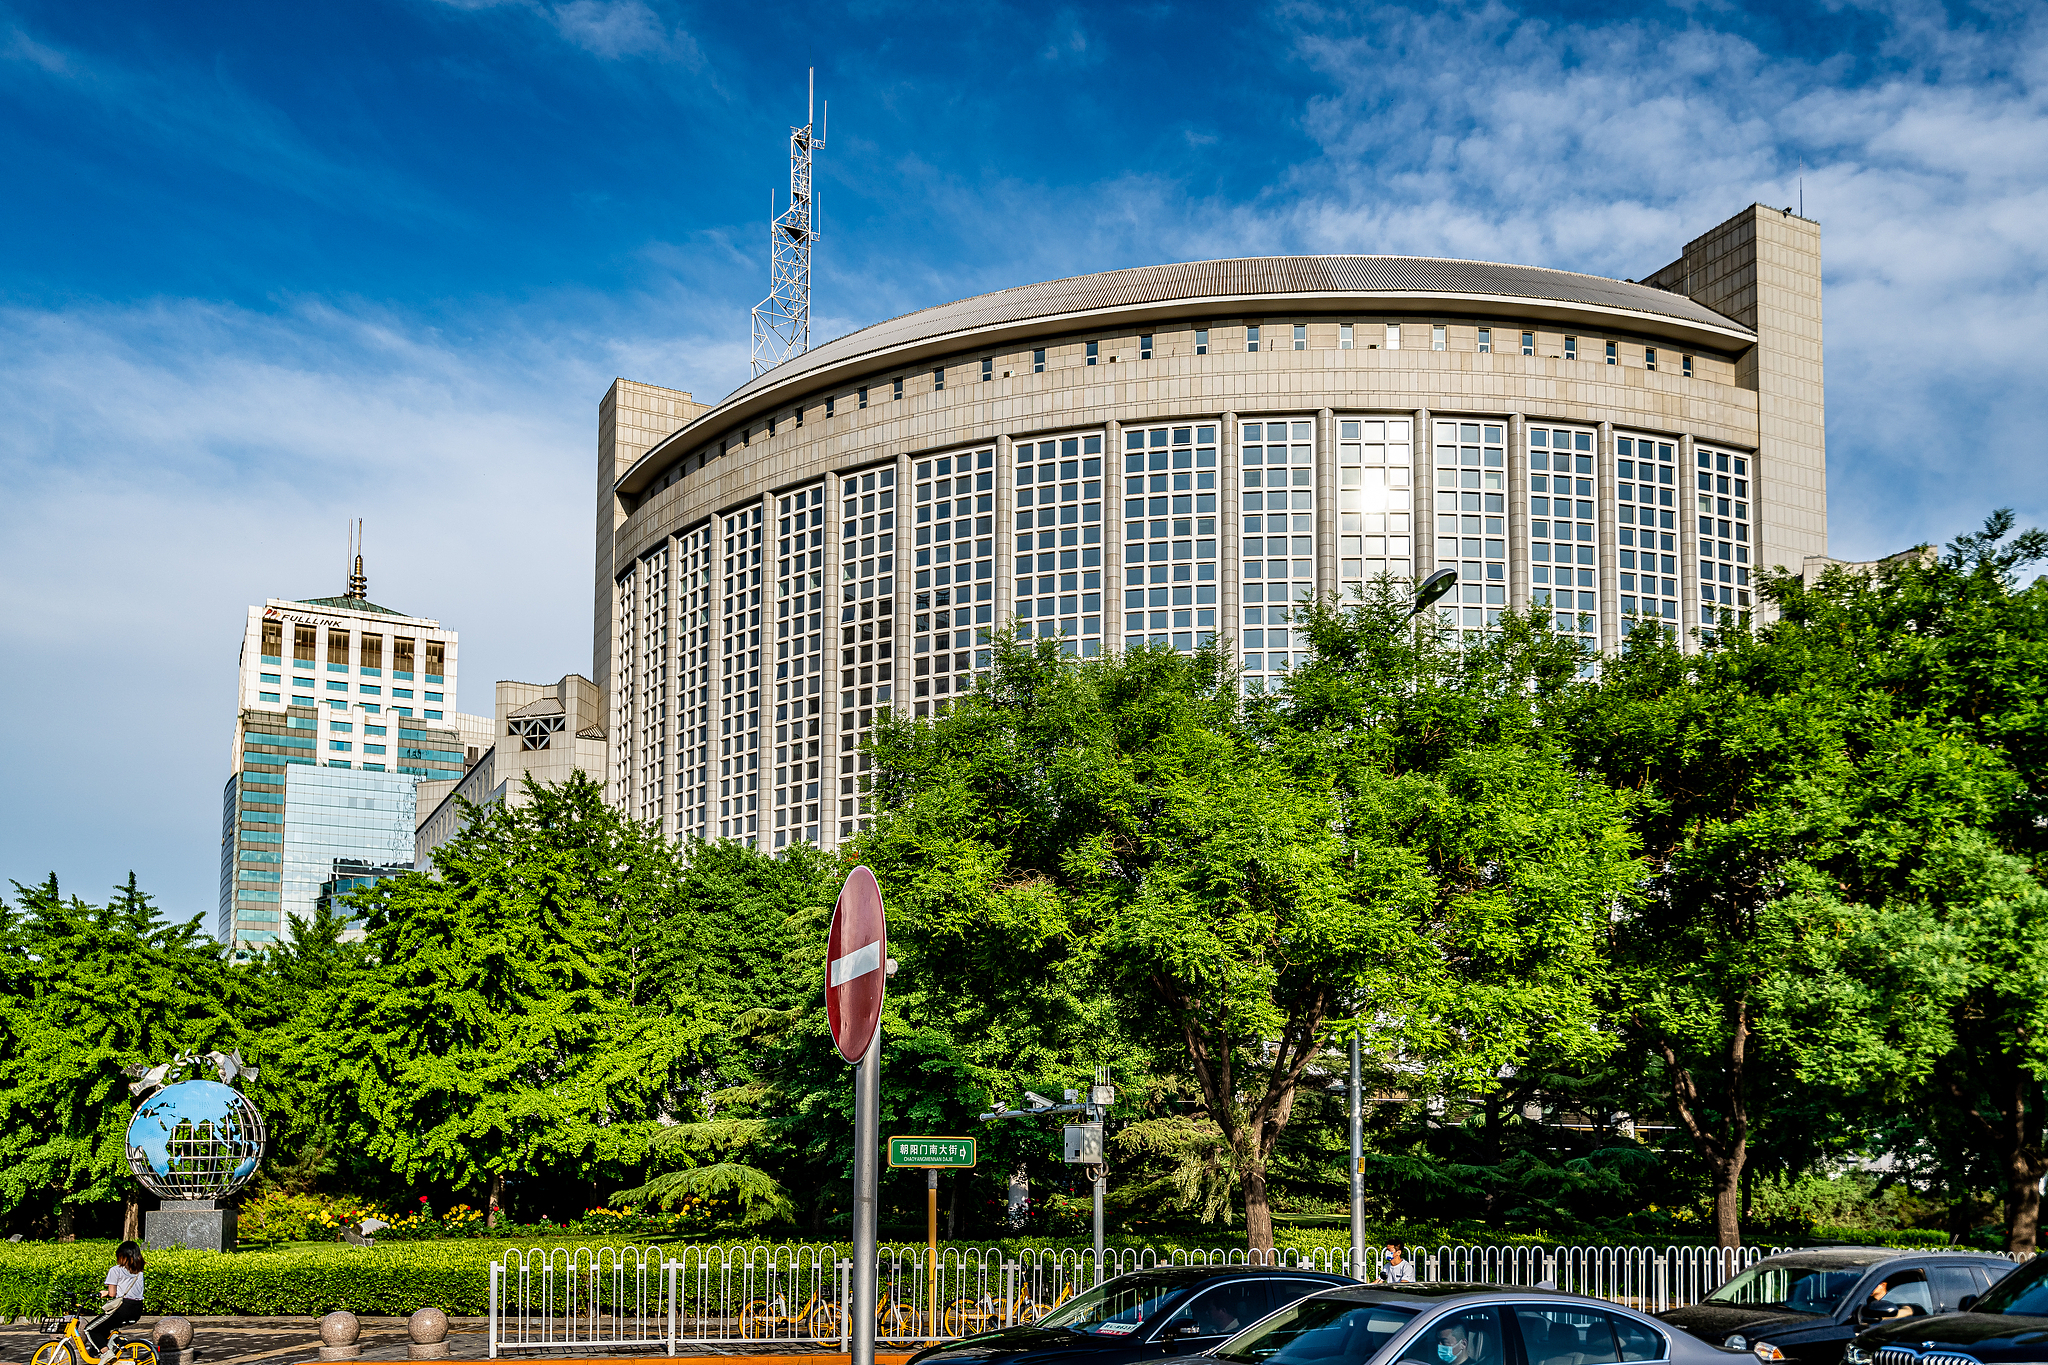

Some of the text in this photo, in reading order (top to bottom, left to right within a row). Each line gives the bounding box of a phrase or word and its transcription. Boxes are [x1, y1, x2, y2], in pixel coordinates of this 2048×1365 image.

[281, 614, 342, 627] FULLLINK
[899, 1143, 958, 1155] 朝阳门南大街
